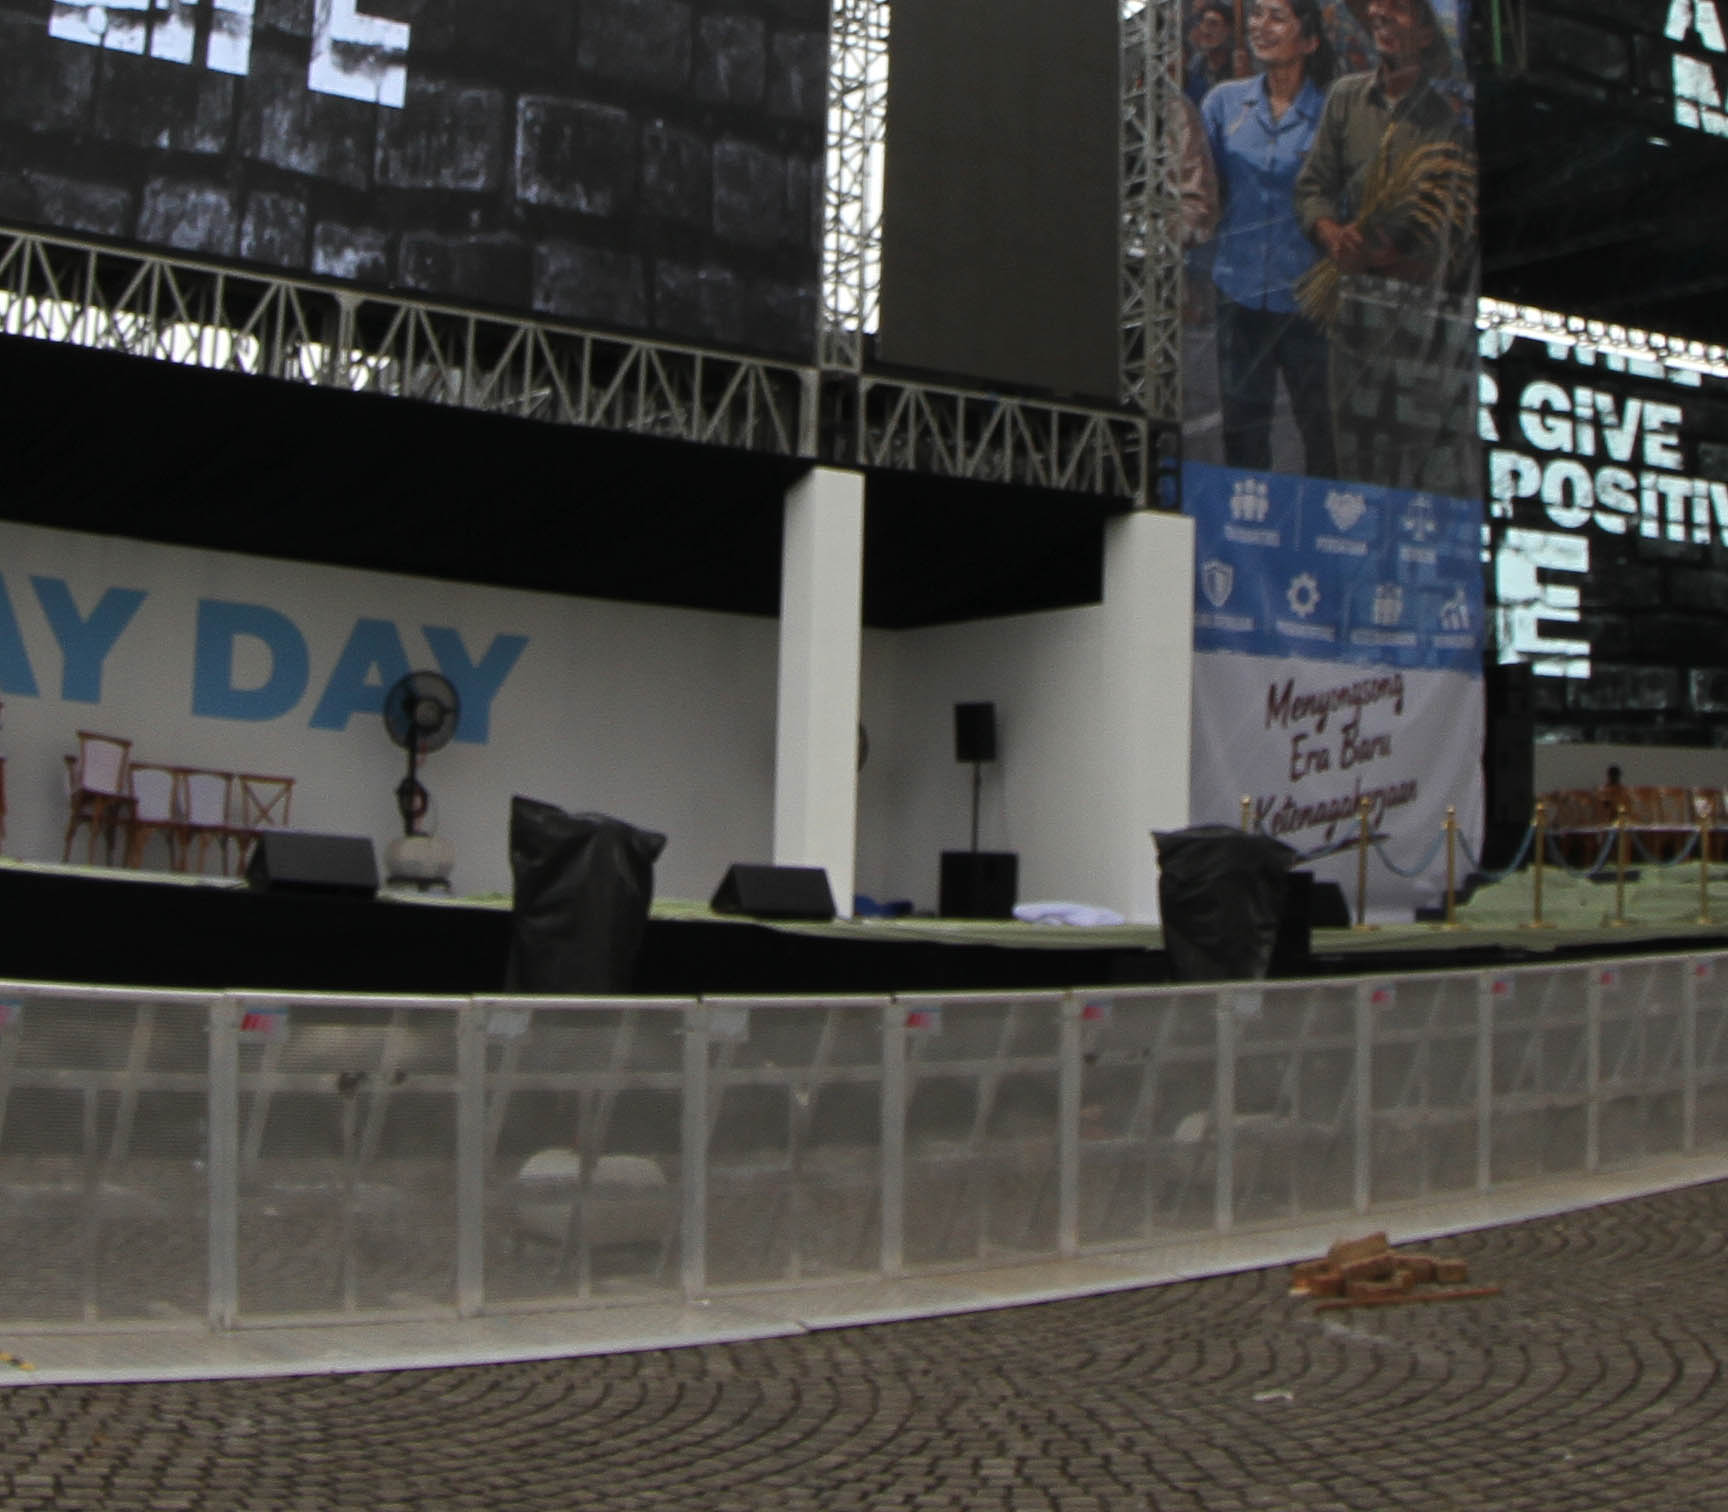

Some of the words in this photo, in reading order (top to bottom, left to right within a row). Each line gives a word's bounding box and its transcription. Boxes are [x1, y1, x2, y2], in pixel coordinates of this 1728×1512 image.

[1519, 381, 1683, 469] GIVE
[192, 597, 530, 746] DAY
[1289, 732, 1330, 782] Era
[1339, 720, 1392, 770] Baru
[1253, 776, 1417, 842] Ketenagakrjaan
